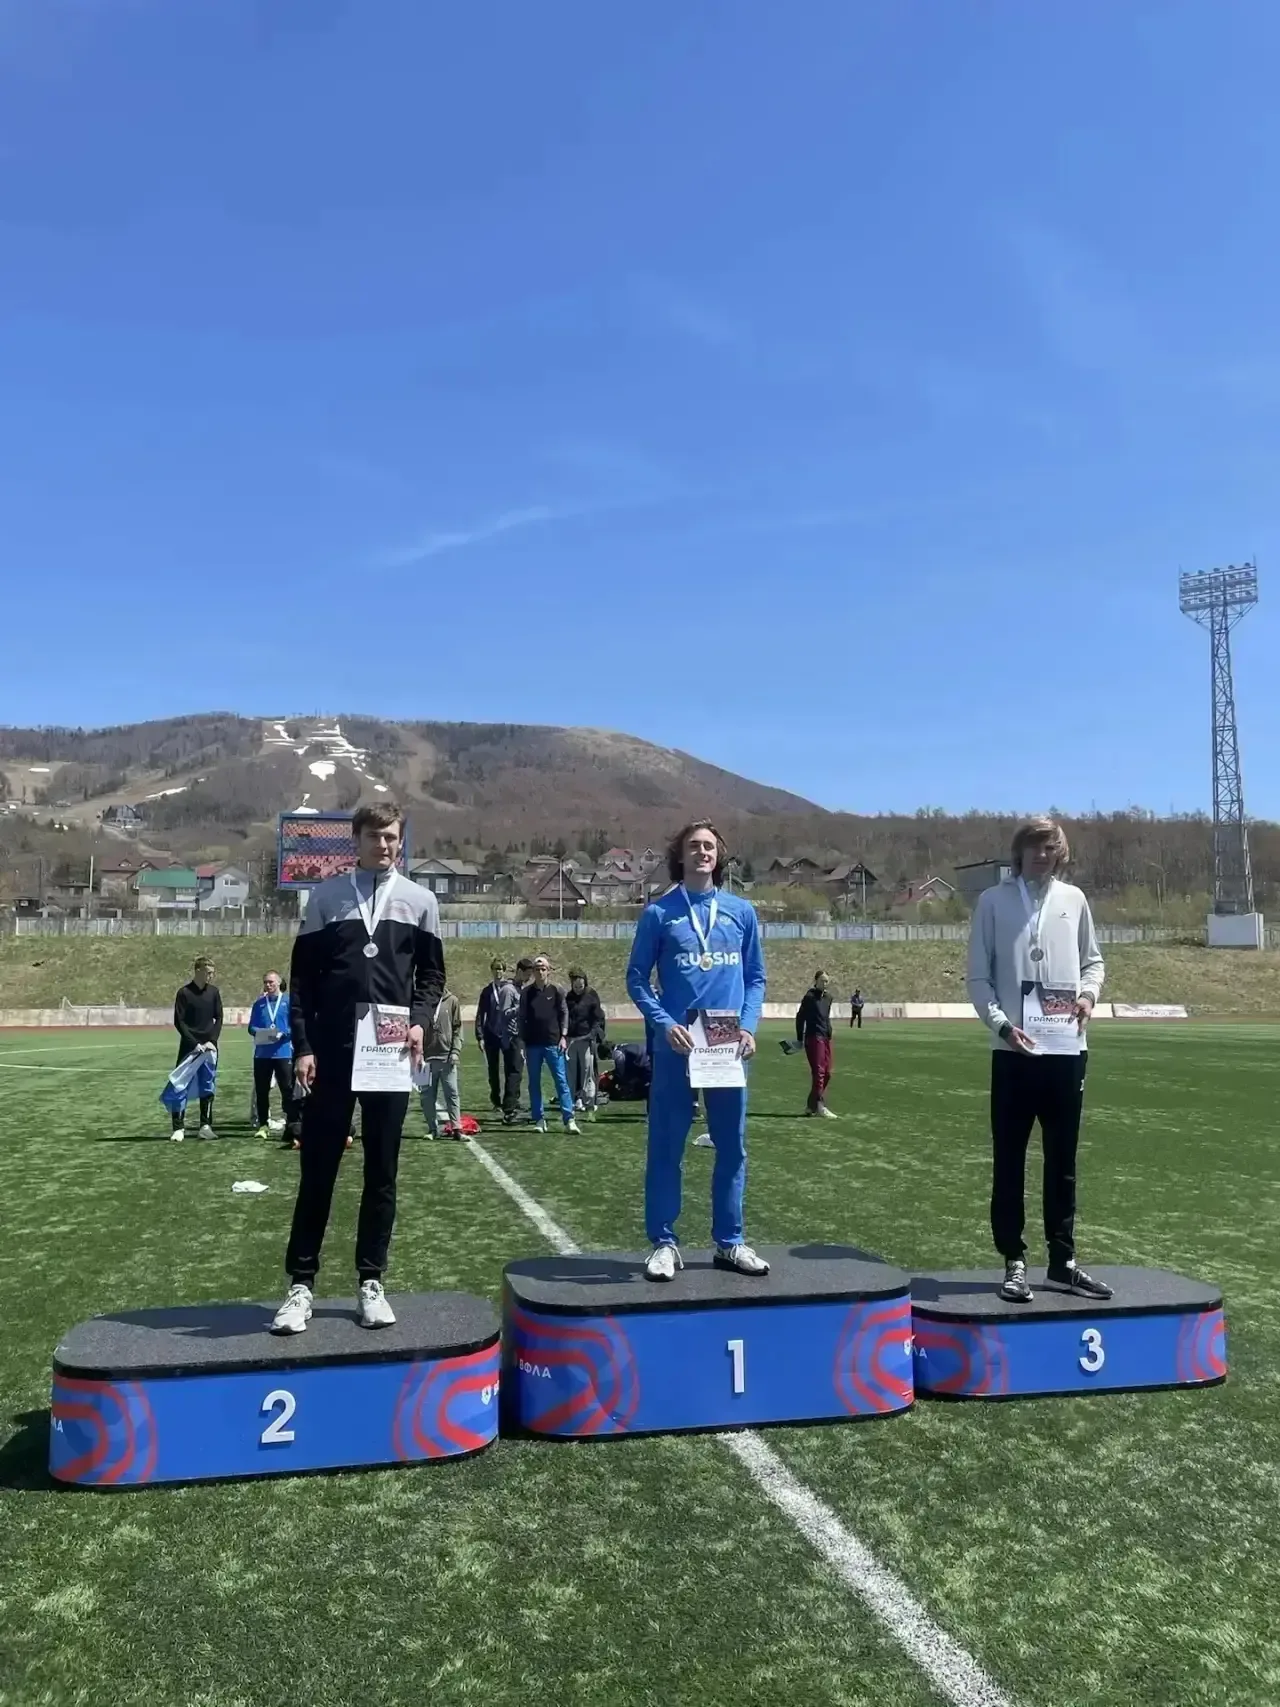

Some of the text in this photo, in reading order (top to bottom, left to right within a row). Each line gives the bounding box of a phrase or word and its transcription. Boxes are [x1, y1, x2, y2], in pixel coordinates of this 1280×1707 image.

[674, 951, 739, 967] RUSSIA
[694, 1047, 734, 1055] ГРАМОТА
[1079, 1327, 1105, 1372] 3
[519, 1358, 552, 1379] ВФЛА
[727, 1339, 745, 1394] 1
[260, 1389, 296, 1445] 2
